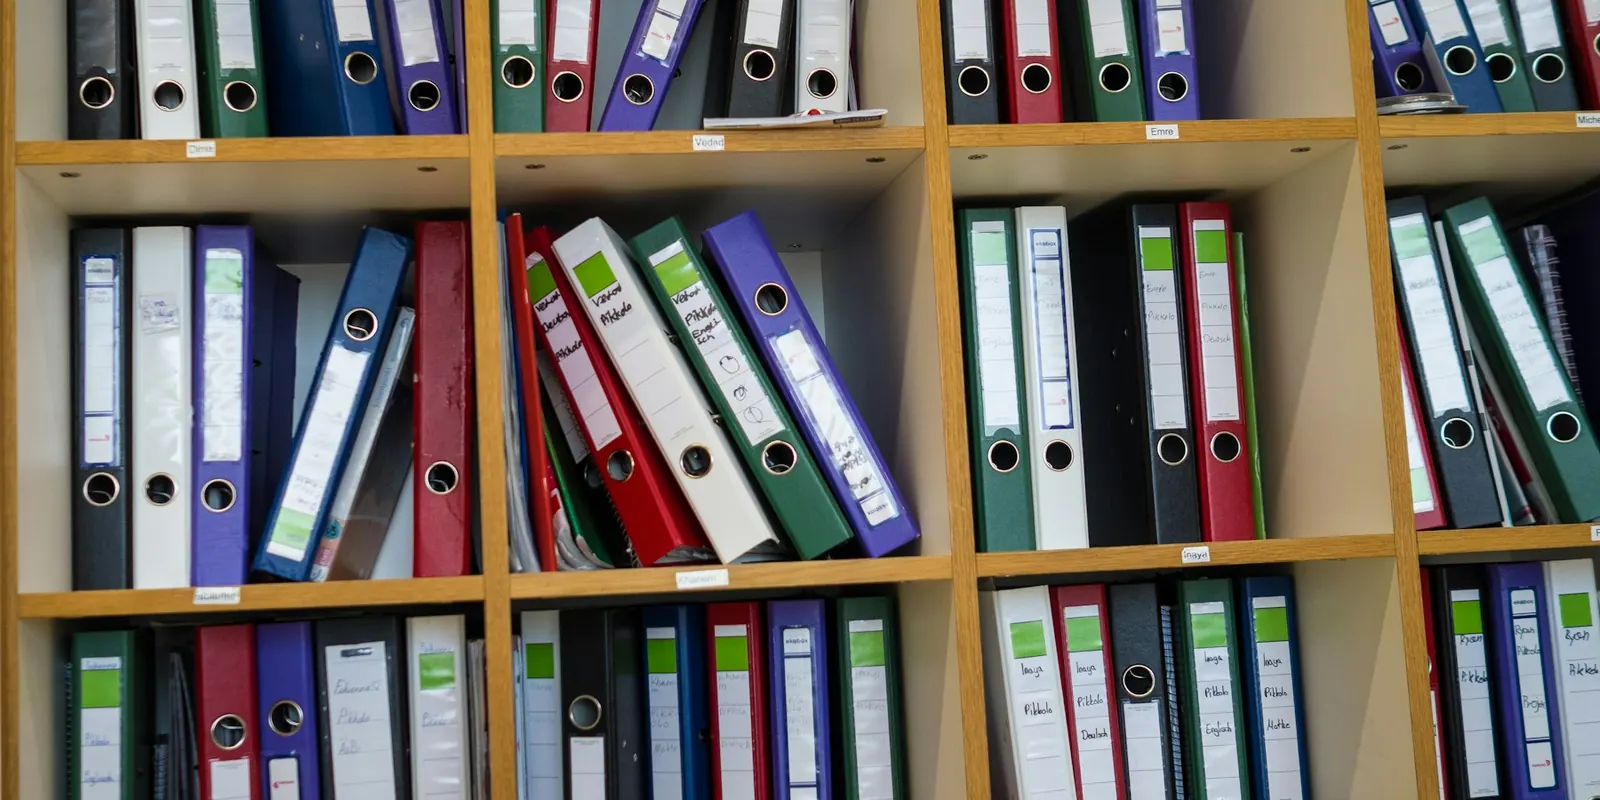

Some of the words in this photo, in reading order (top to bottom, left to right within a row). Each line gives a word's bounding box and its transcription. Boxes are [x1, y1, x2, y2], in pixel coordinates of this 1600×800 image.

[1150, 127, 1174, 136] Emre
[694, 136, 724, 147] Vedad
[1021, 662, 1044, 678] Inaya
[1075, 661, 1097, 676] Inaya
[1204, 684, 1229, 698] Pikkolo
[1264, 685, 1288, 698] Pikkolo
[1076, 693, 1104, 708] Pikkolo
[1024, 701, 1053, 716] Pikkolo
[1081, 727, 1109, 741] Deutsch
[1205, 720, 1232, 737] Englisch
